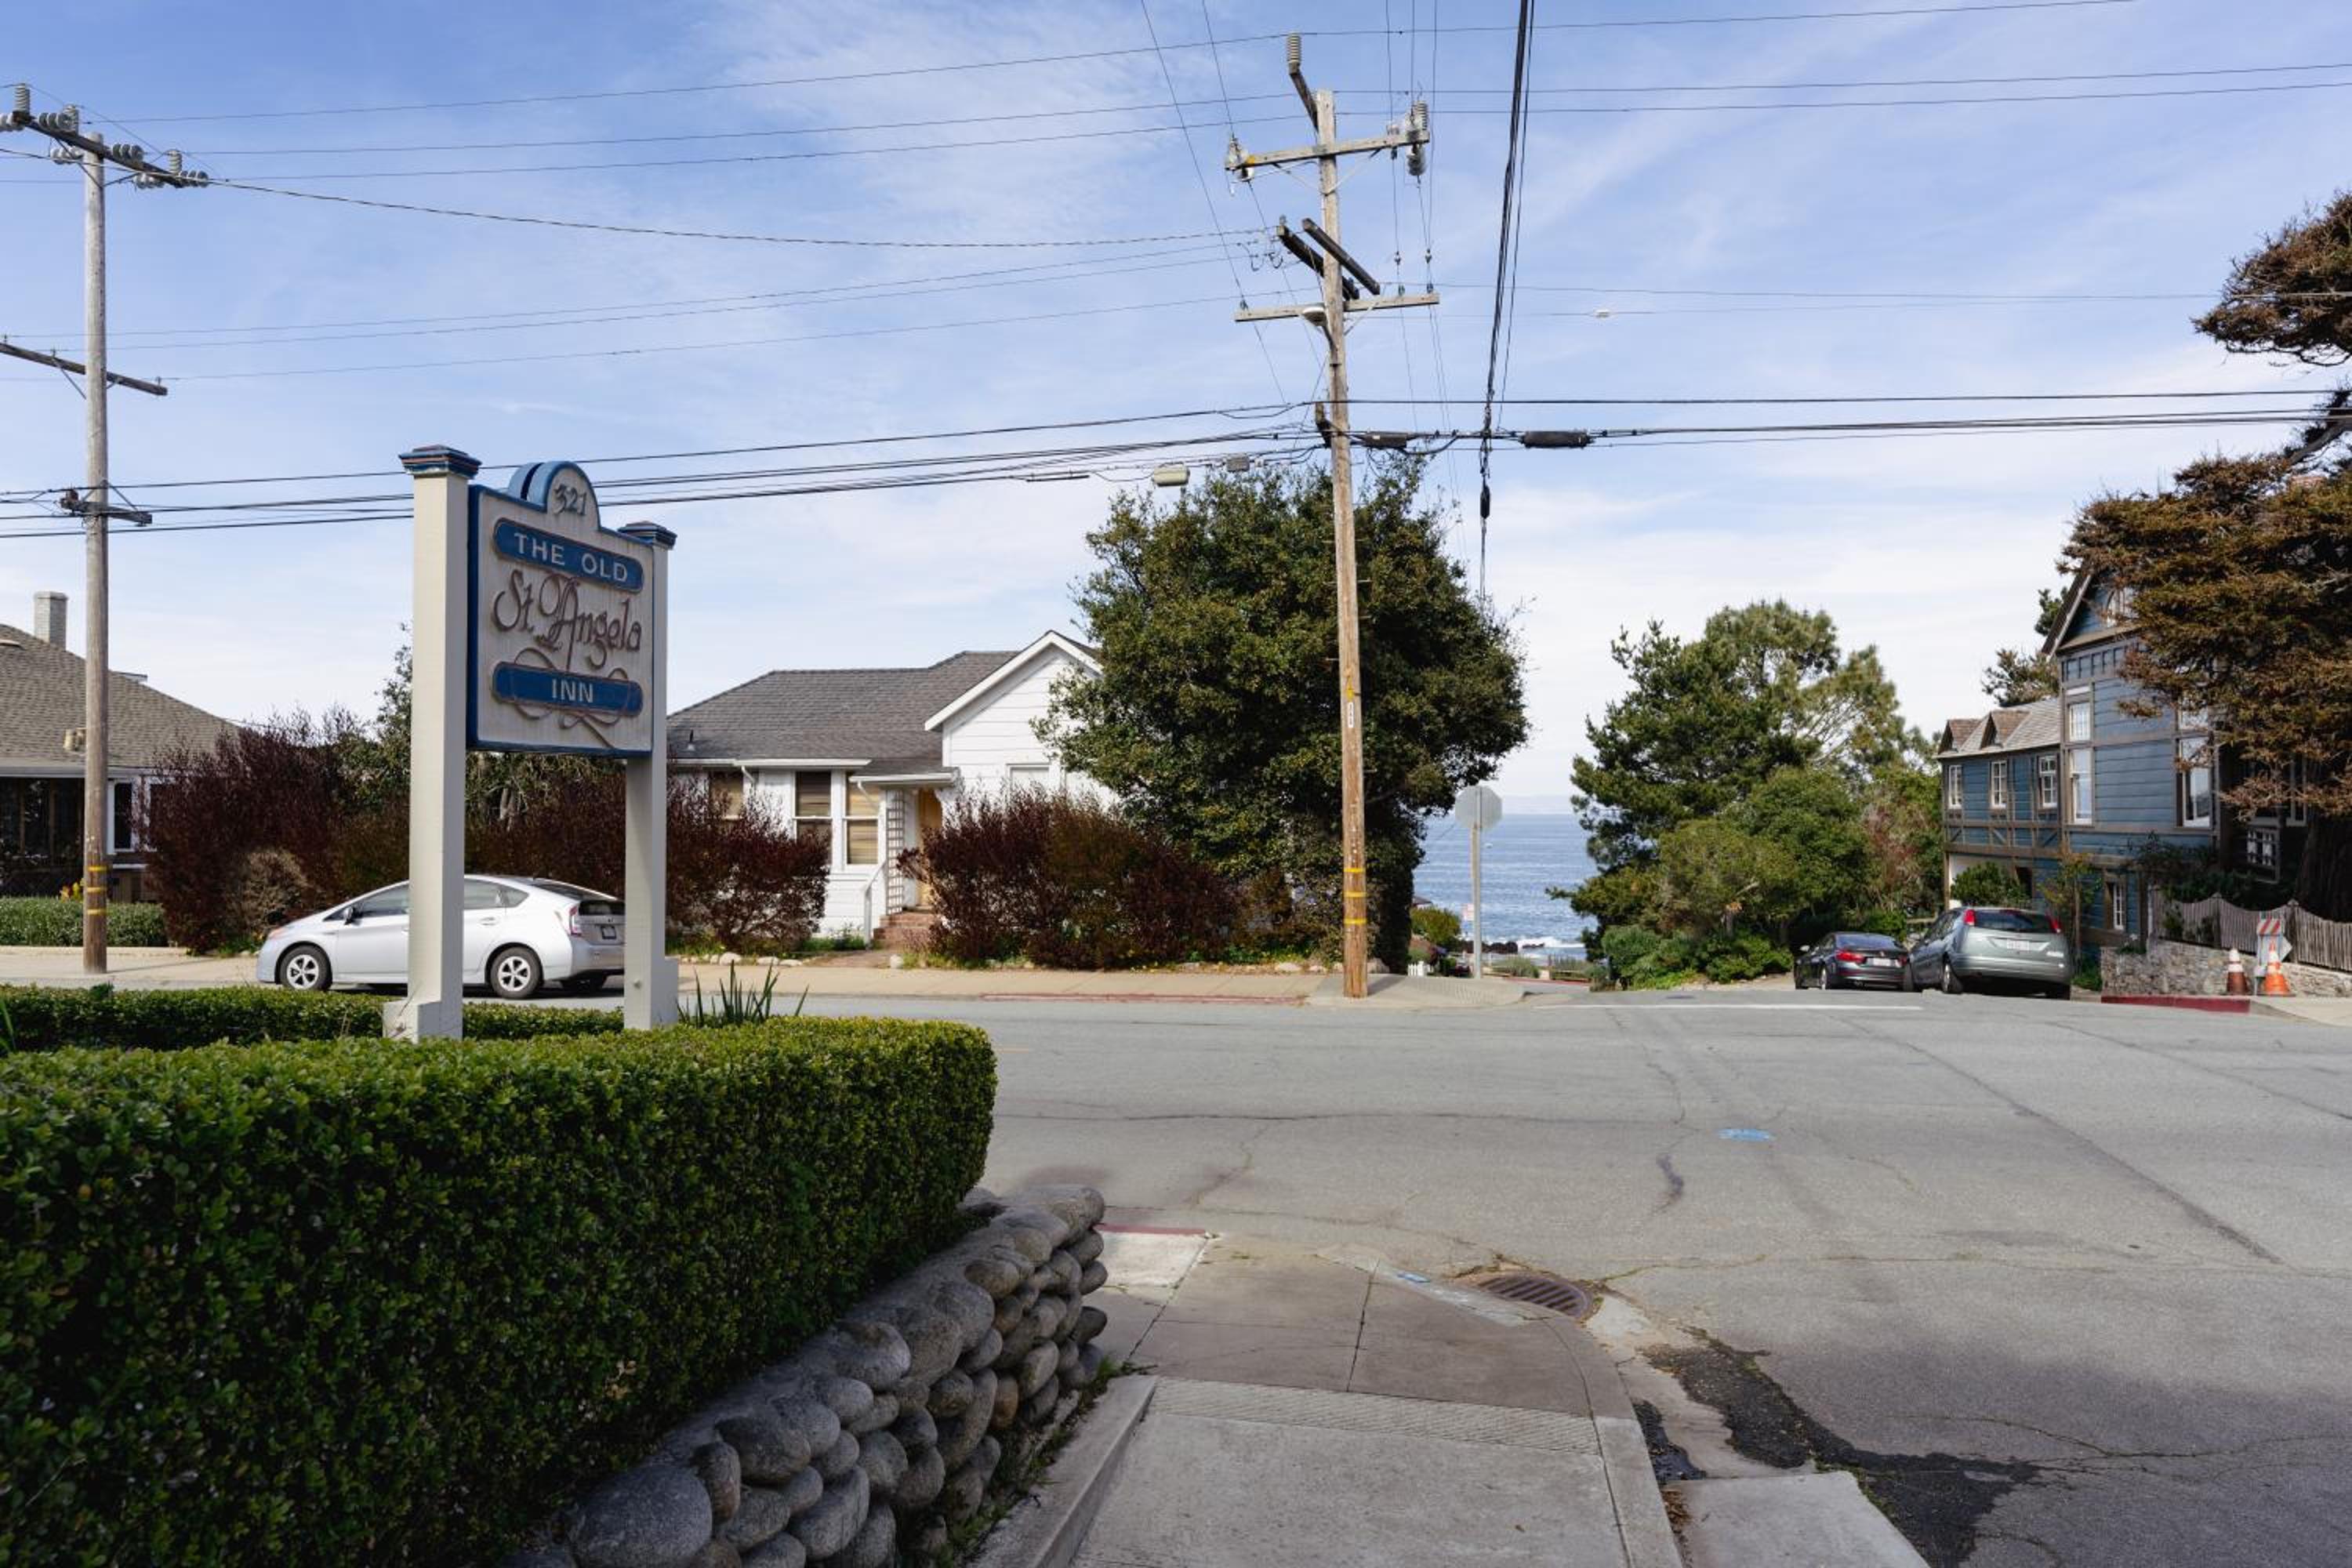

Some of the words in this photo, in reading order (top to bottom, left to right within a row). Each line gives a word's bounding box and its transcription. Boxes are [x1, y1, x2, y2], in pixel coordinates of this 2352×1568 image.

[554, 483, 587, 517] 321
[514, 532, 565, 566] THE
[581, 553, 628, 583] OLD
[552, 679, 593, 703] INN
